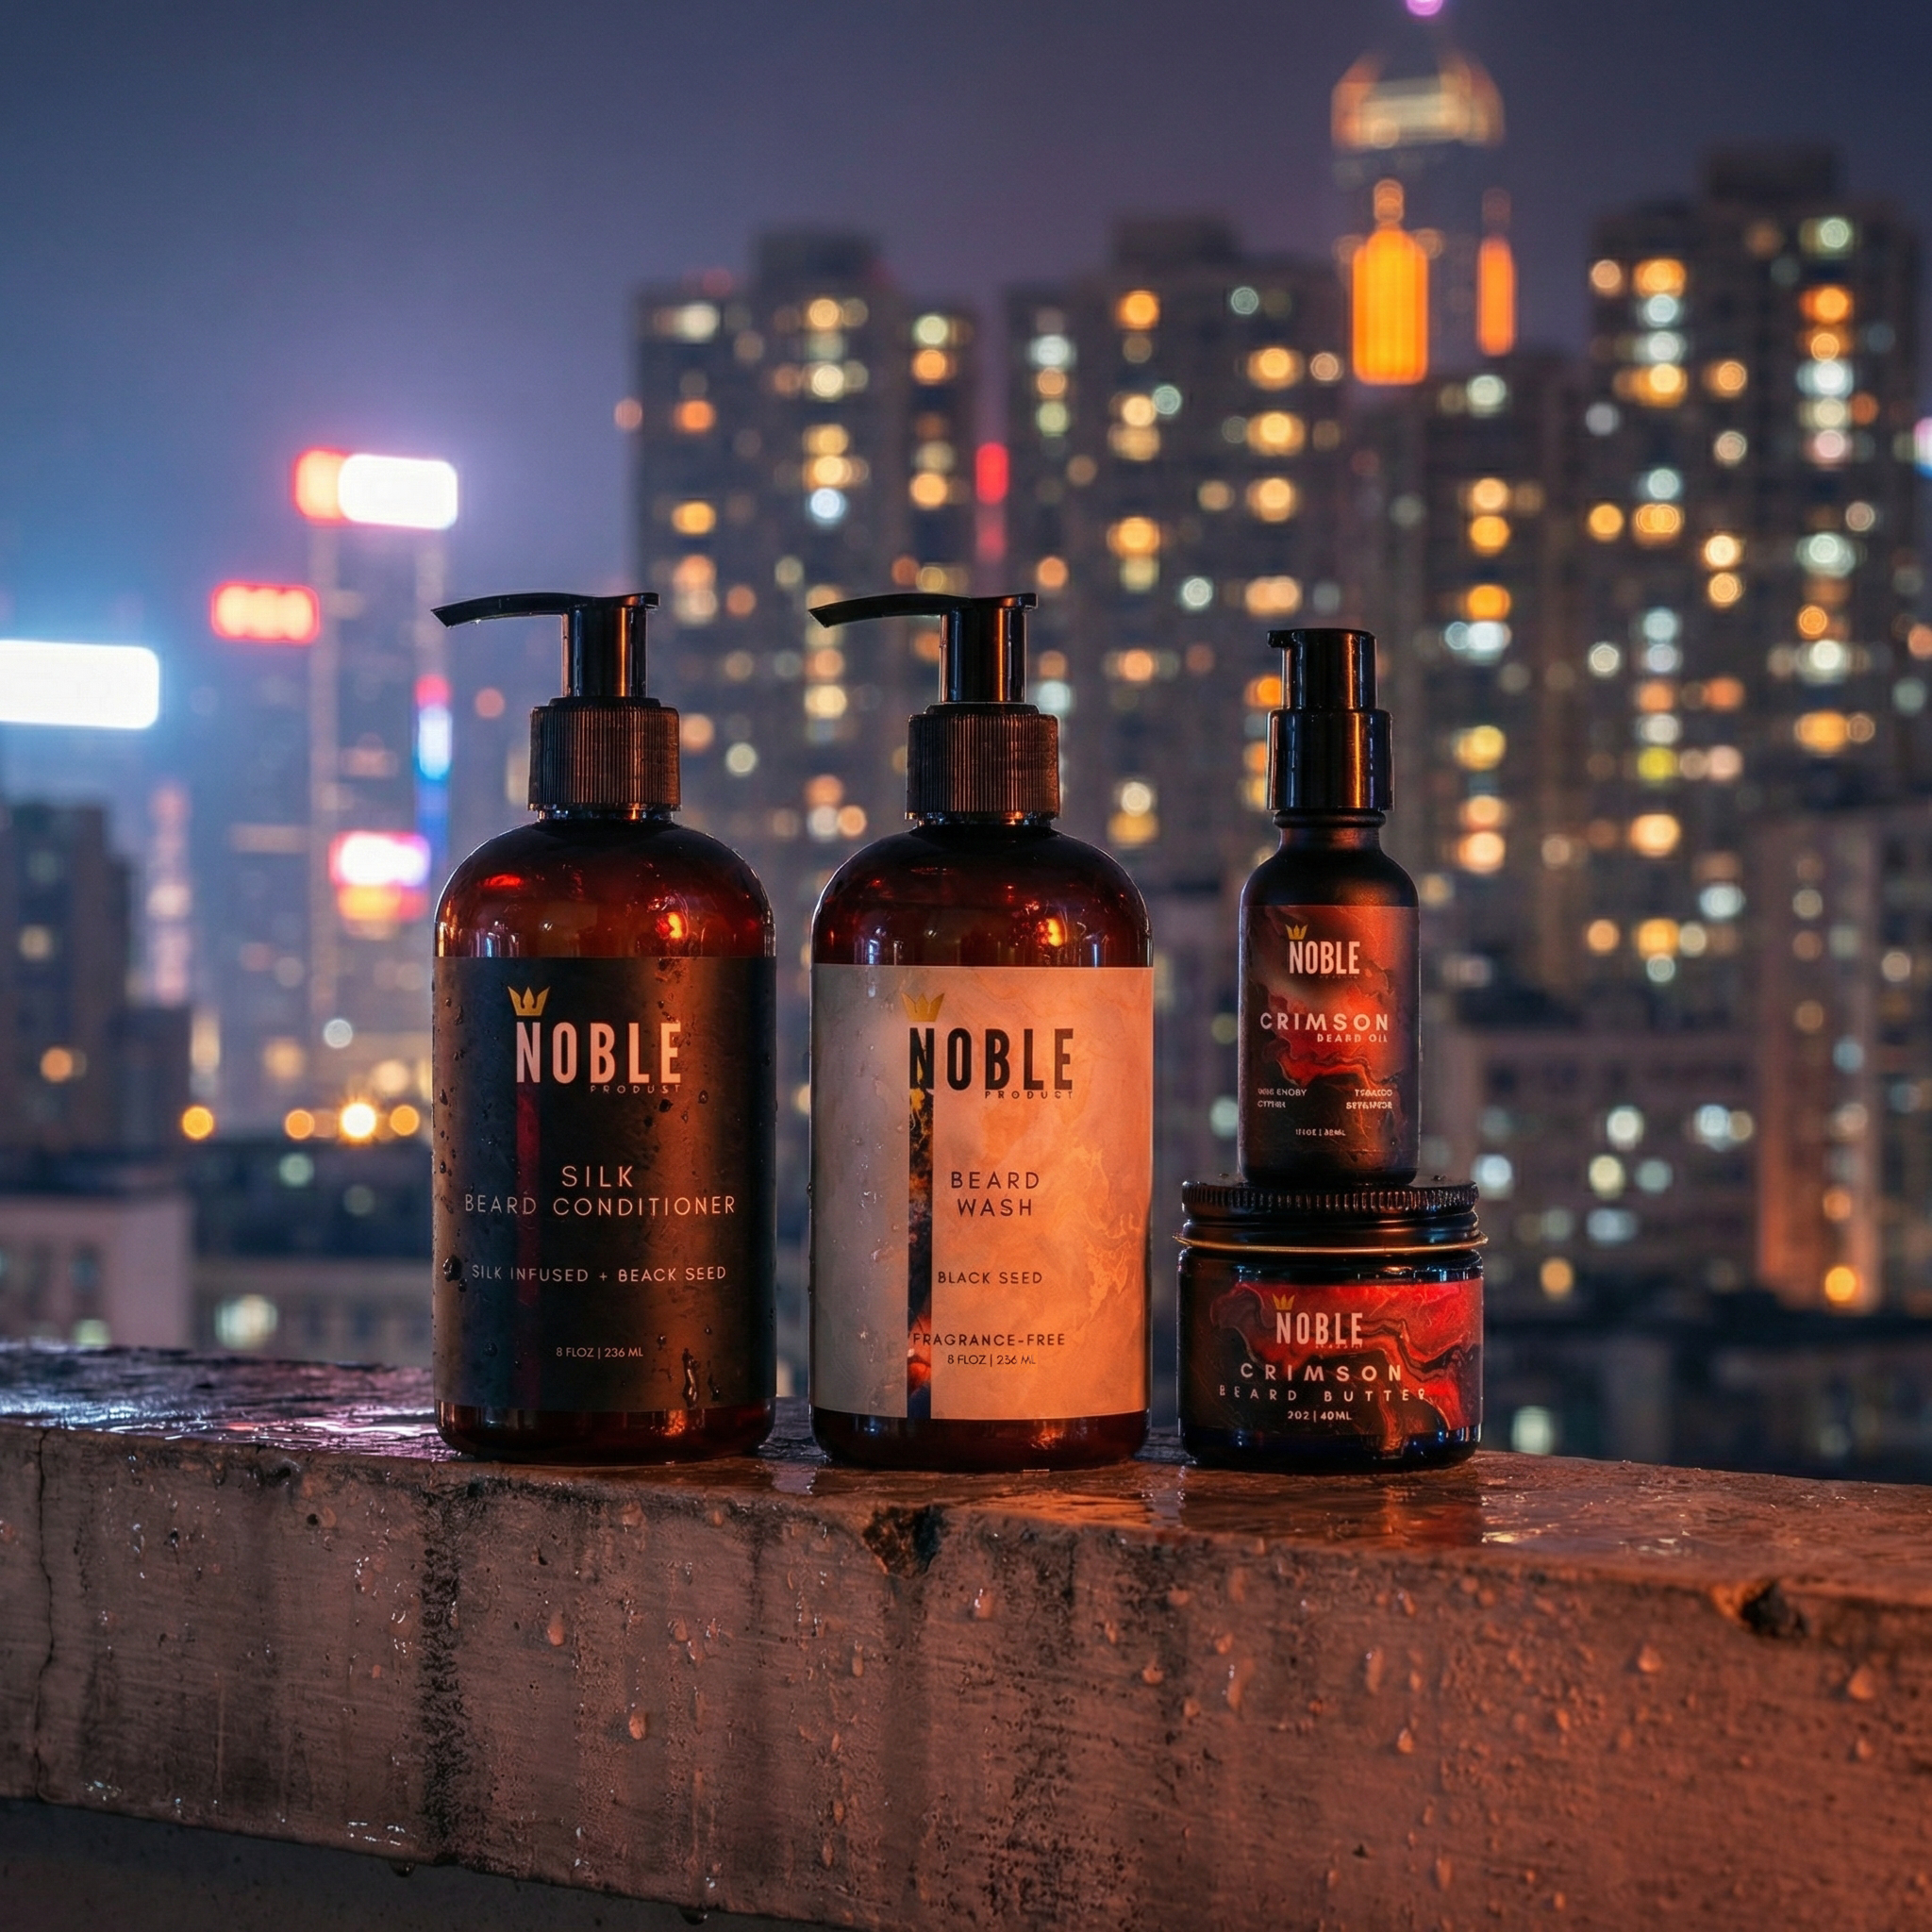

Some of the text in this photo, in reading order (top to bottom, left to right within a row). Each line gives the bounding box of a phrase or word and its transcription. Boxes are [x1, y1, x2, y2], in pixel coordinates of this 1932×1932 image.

[1289, 941, 1360, 974] NOBLE
[1260, 1012, 1389, 1031] CRIMSON
[516, 1022, 681, 1084] NOBLE
[909, 1027, 1074, 1091] NOBLE
[561, 1165, 633, 1188] SILK
[951, 1171, 1040, 1190] BEARD
[465, 1193, 735, 1217] BEARD CONDITIONER
[958, 1198, 1032, 1217] WASH
[472, 1264, 502, 1280] SILK
[510, 1267, 589, 1282] INFUSED
[685, 1266, 726, 1280] SEED
[938, 1271, 1042, 1284] BLACK SEED
[1276, 1312, 1363, 1345] NOBLE
[913, 1333, 1065, 1346] FRAGRANCE-FREE
[556, 1347, 563, 1357] 8
[605, 1347, 625, 1357] 236
[627, 1347, 643, 1357] ML
[947, 1354, 955, 1365] 8
[996, 1355, 1018, 1365] 236
[1020, 1355, 1036, 1365] ML
[1241, 1362, 1402, 1382] CRIMSON
